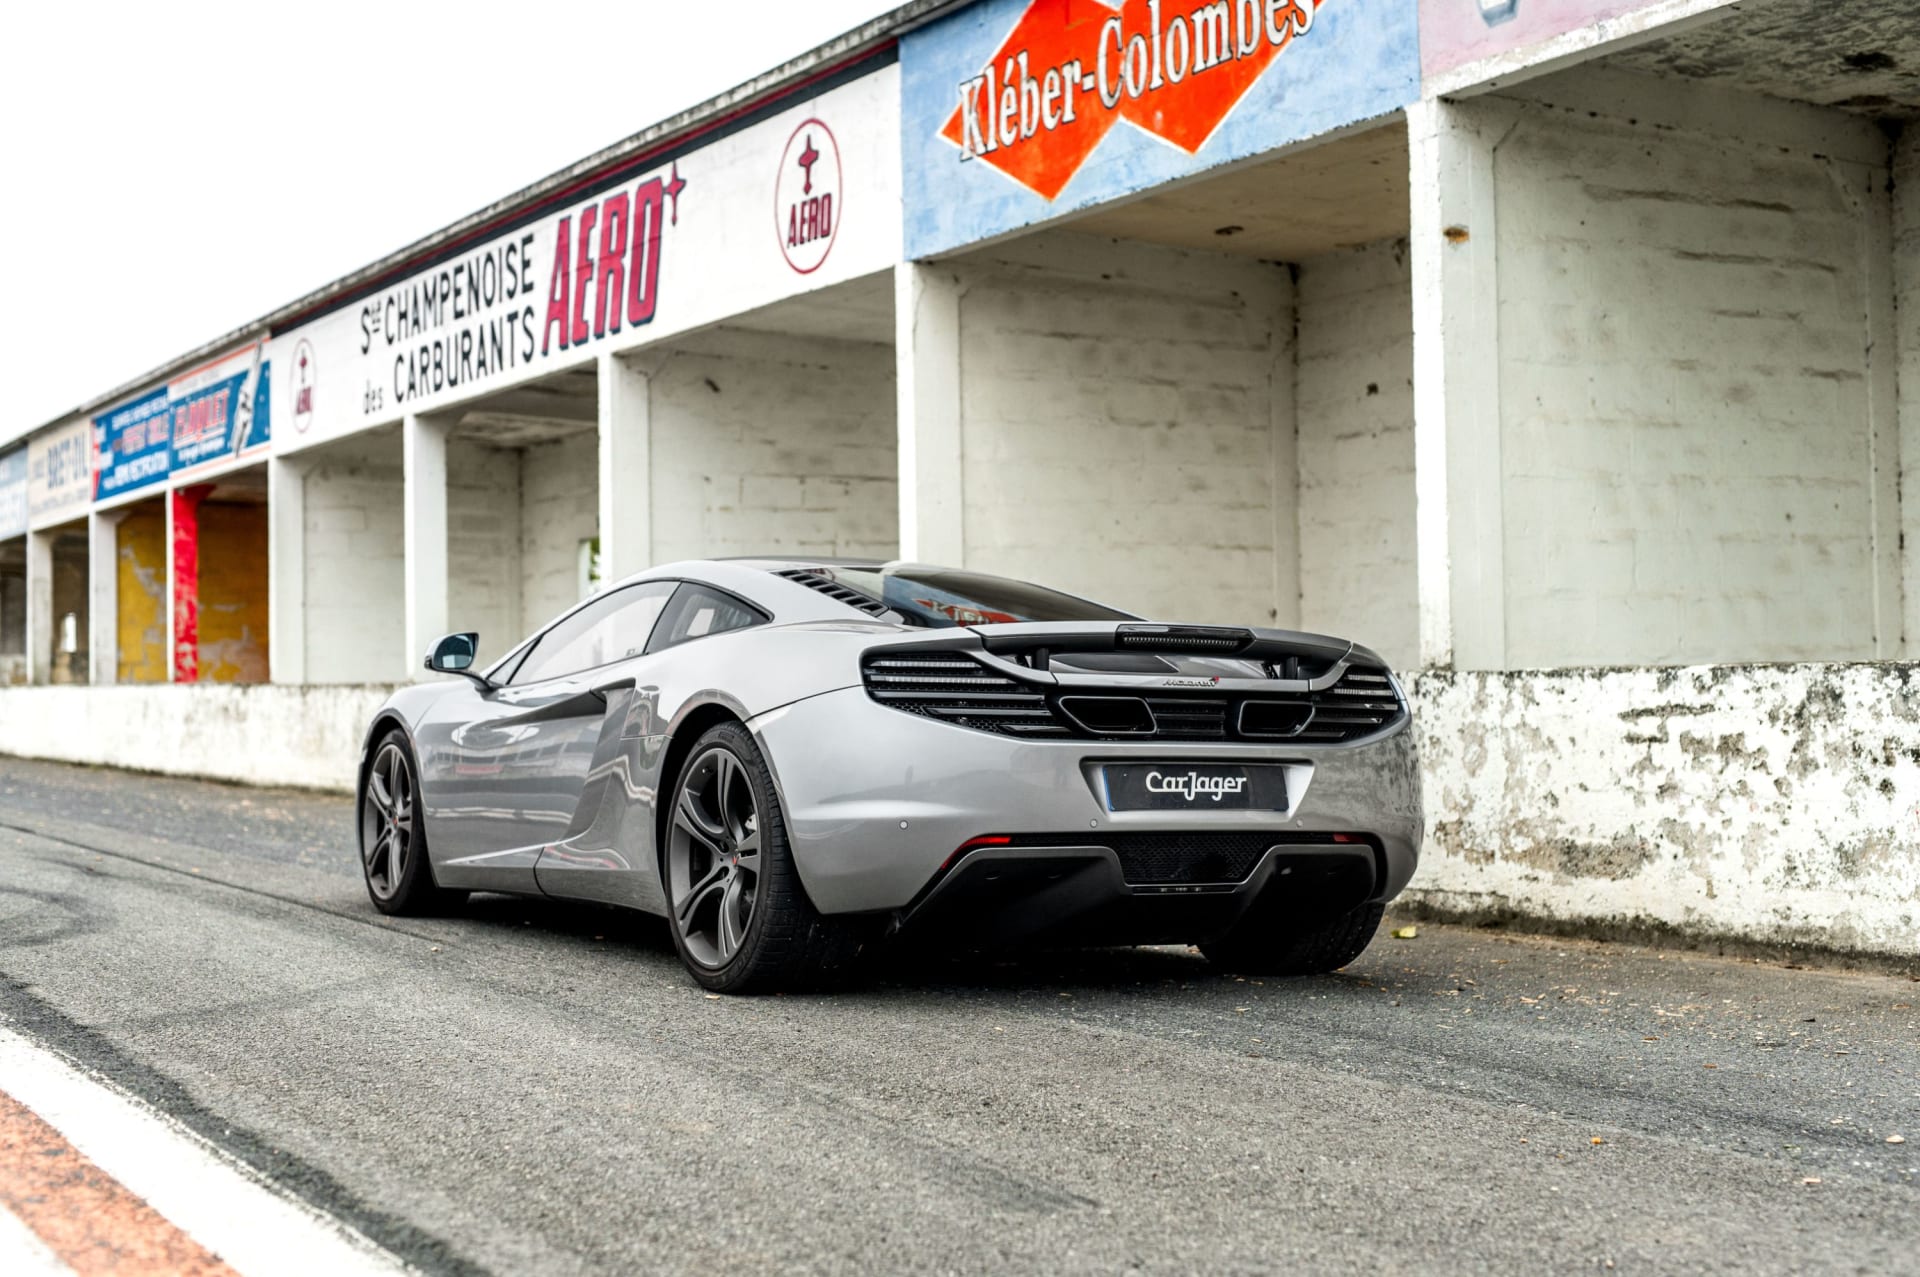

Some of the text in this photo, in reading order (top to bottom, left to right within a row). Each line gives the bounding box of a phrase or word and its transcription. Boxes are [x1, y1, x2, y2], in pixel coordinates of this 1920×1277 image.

[541, 176, 664, 357] AERO
[787, 193, 832, 249] AERO
[385, 233, 534, 346] CHAMPENOISE
[363, 305, 535, 414] des CARBURANTS
[1145, 771, 1248, 801] CarJager
